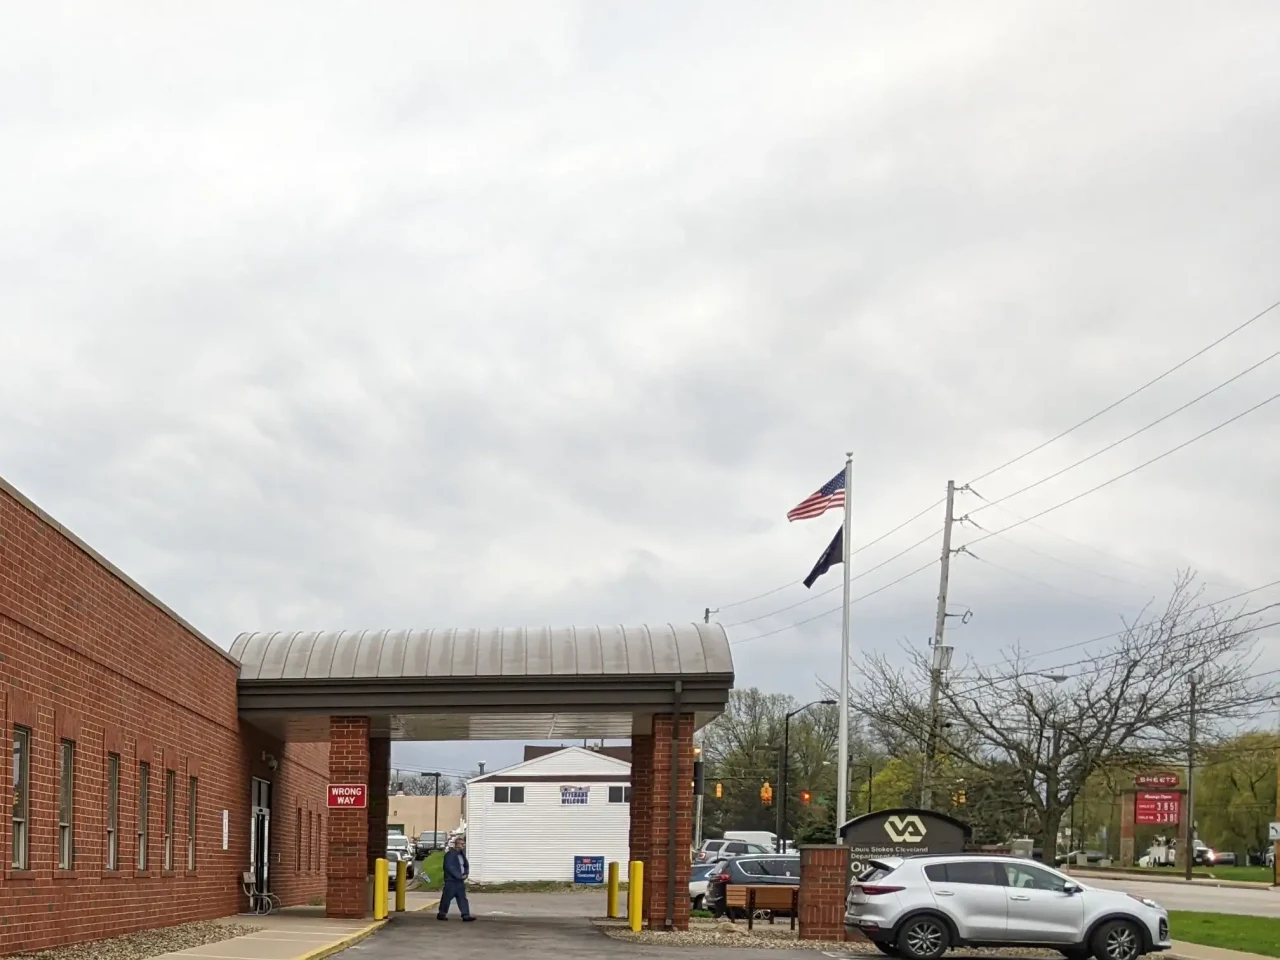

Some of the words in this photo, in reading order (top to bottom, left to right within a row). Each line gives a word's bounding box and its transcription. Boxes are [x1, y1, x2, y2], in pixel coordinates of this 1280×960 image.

[331, 787, 362, 796] WRONG
[337, 796, 356, 805] WAY
[576, 863, 602, 873] garrett
